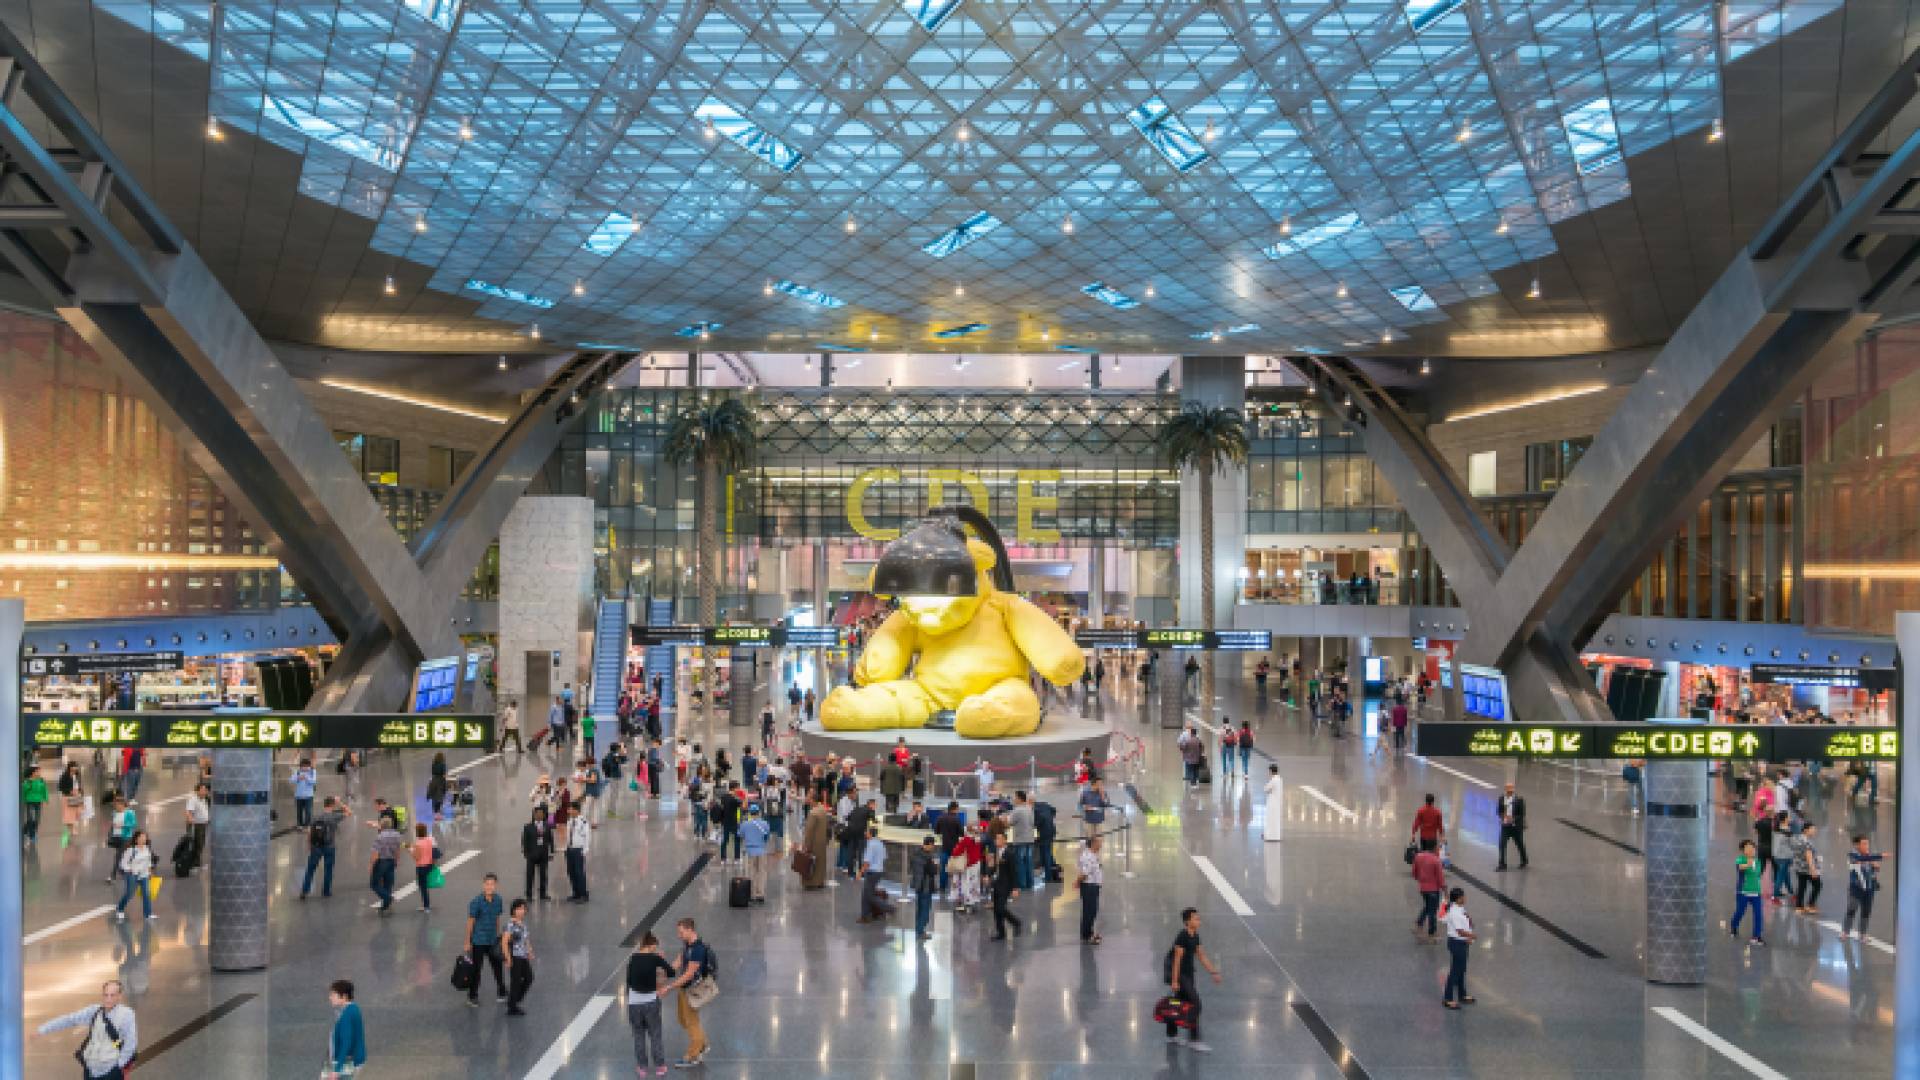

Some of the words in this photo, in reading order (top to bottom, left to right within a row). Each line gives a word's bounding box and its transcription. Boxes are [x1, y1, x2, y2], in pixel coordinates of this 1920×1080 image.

[69, 720, 87, 741] A
[201, 721, 257, 741] CDE
[414, 720, 428, 741] B
[1506, 731, 1526, 751] A
[1649, 733, 1705, 753] CDE
[1861, 733, 1875, 754] B
